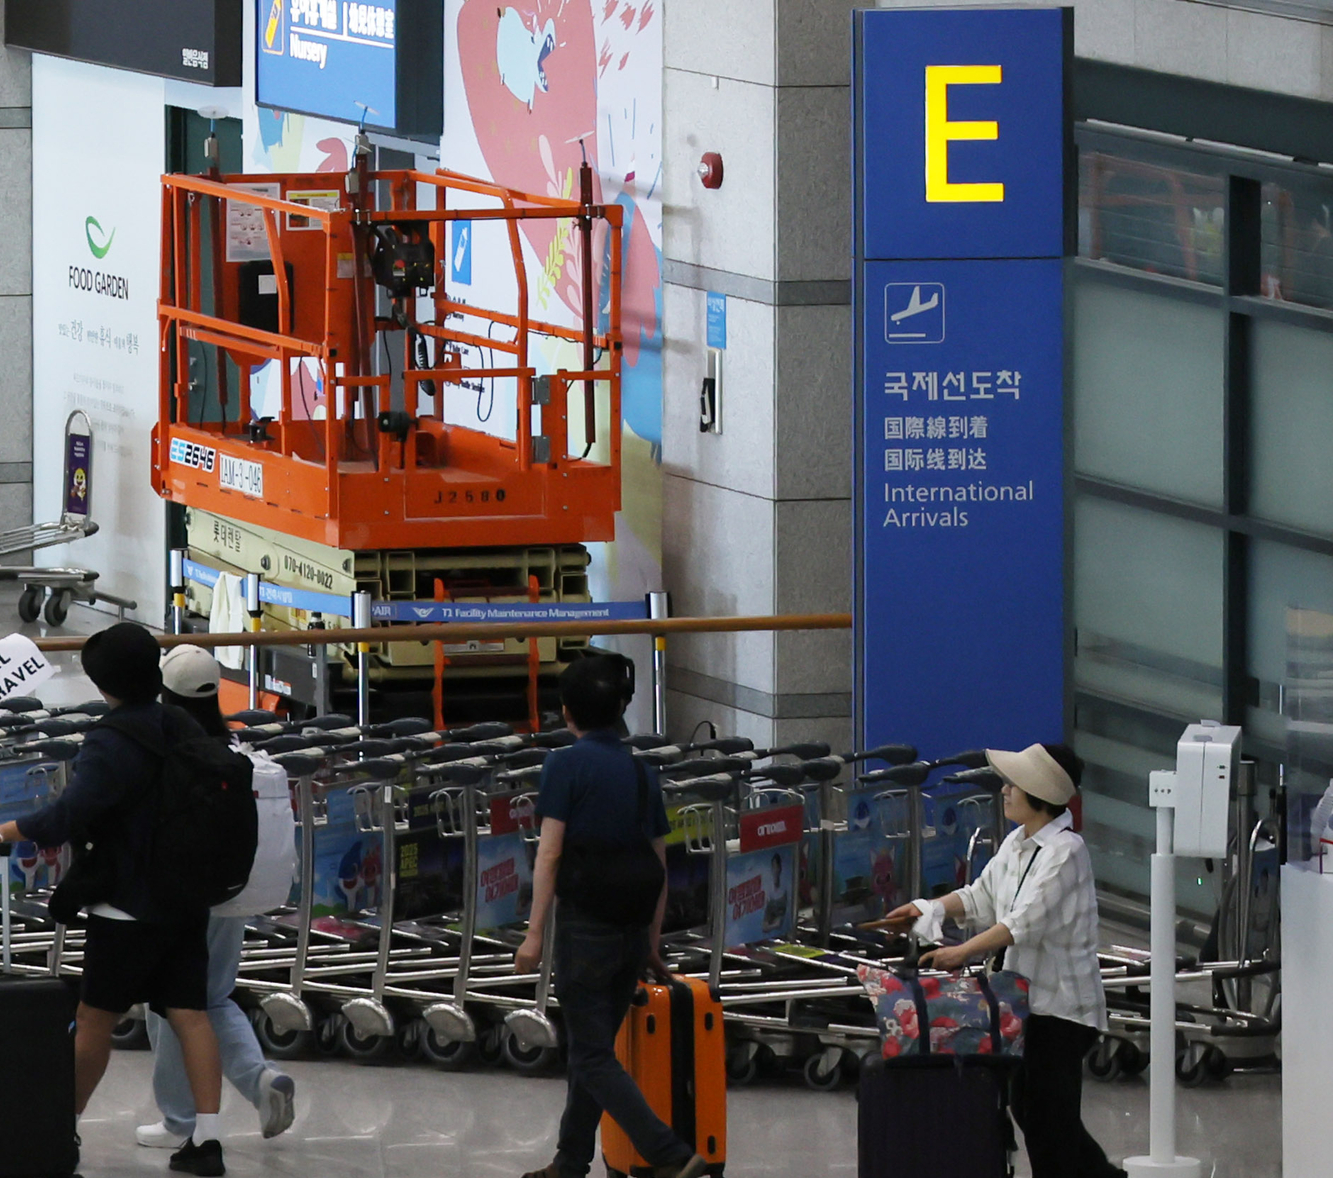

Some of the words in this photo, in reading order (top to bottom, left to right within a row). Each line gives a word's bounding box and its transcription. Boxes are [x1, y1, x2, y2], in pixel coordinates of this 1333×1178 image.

[290, 33, 328, 69] Nursery
[925, 65, 1004, 202] E
[69, 265, 93, 291] FOOD
[94, 271, 129, 301] GARDEN
[884, 370, 1022, 401] 국제선도착
[884, 416, 988, 440] 国際線到着
[171, 440, 214, 470] ES2646
[884, 448, 987, 472] 国际线到达
[884, 480, 1033, 502] International
[883, 506, 969, 527] Arrivals
[455, 608, 486, 620] Facility
[487, 608, 547, 618] Maintenance
[549, 608, 610, 620] Management
